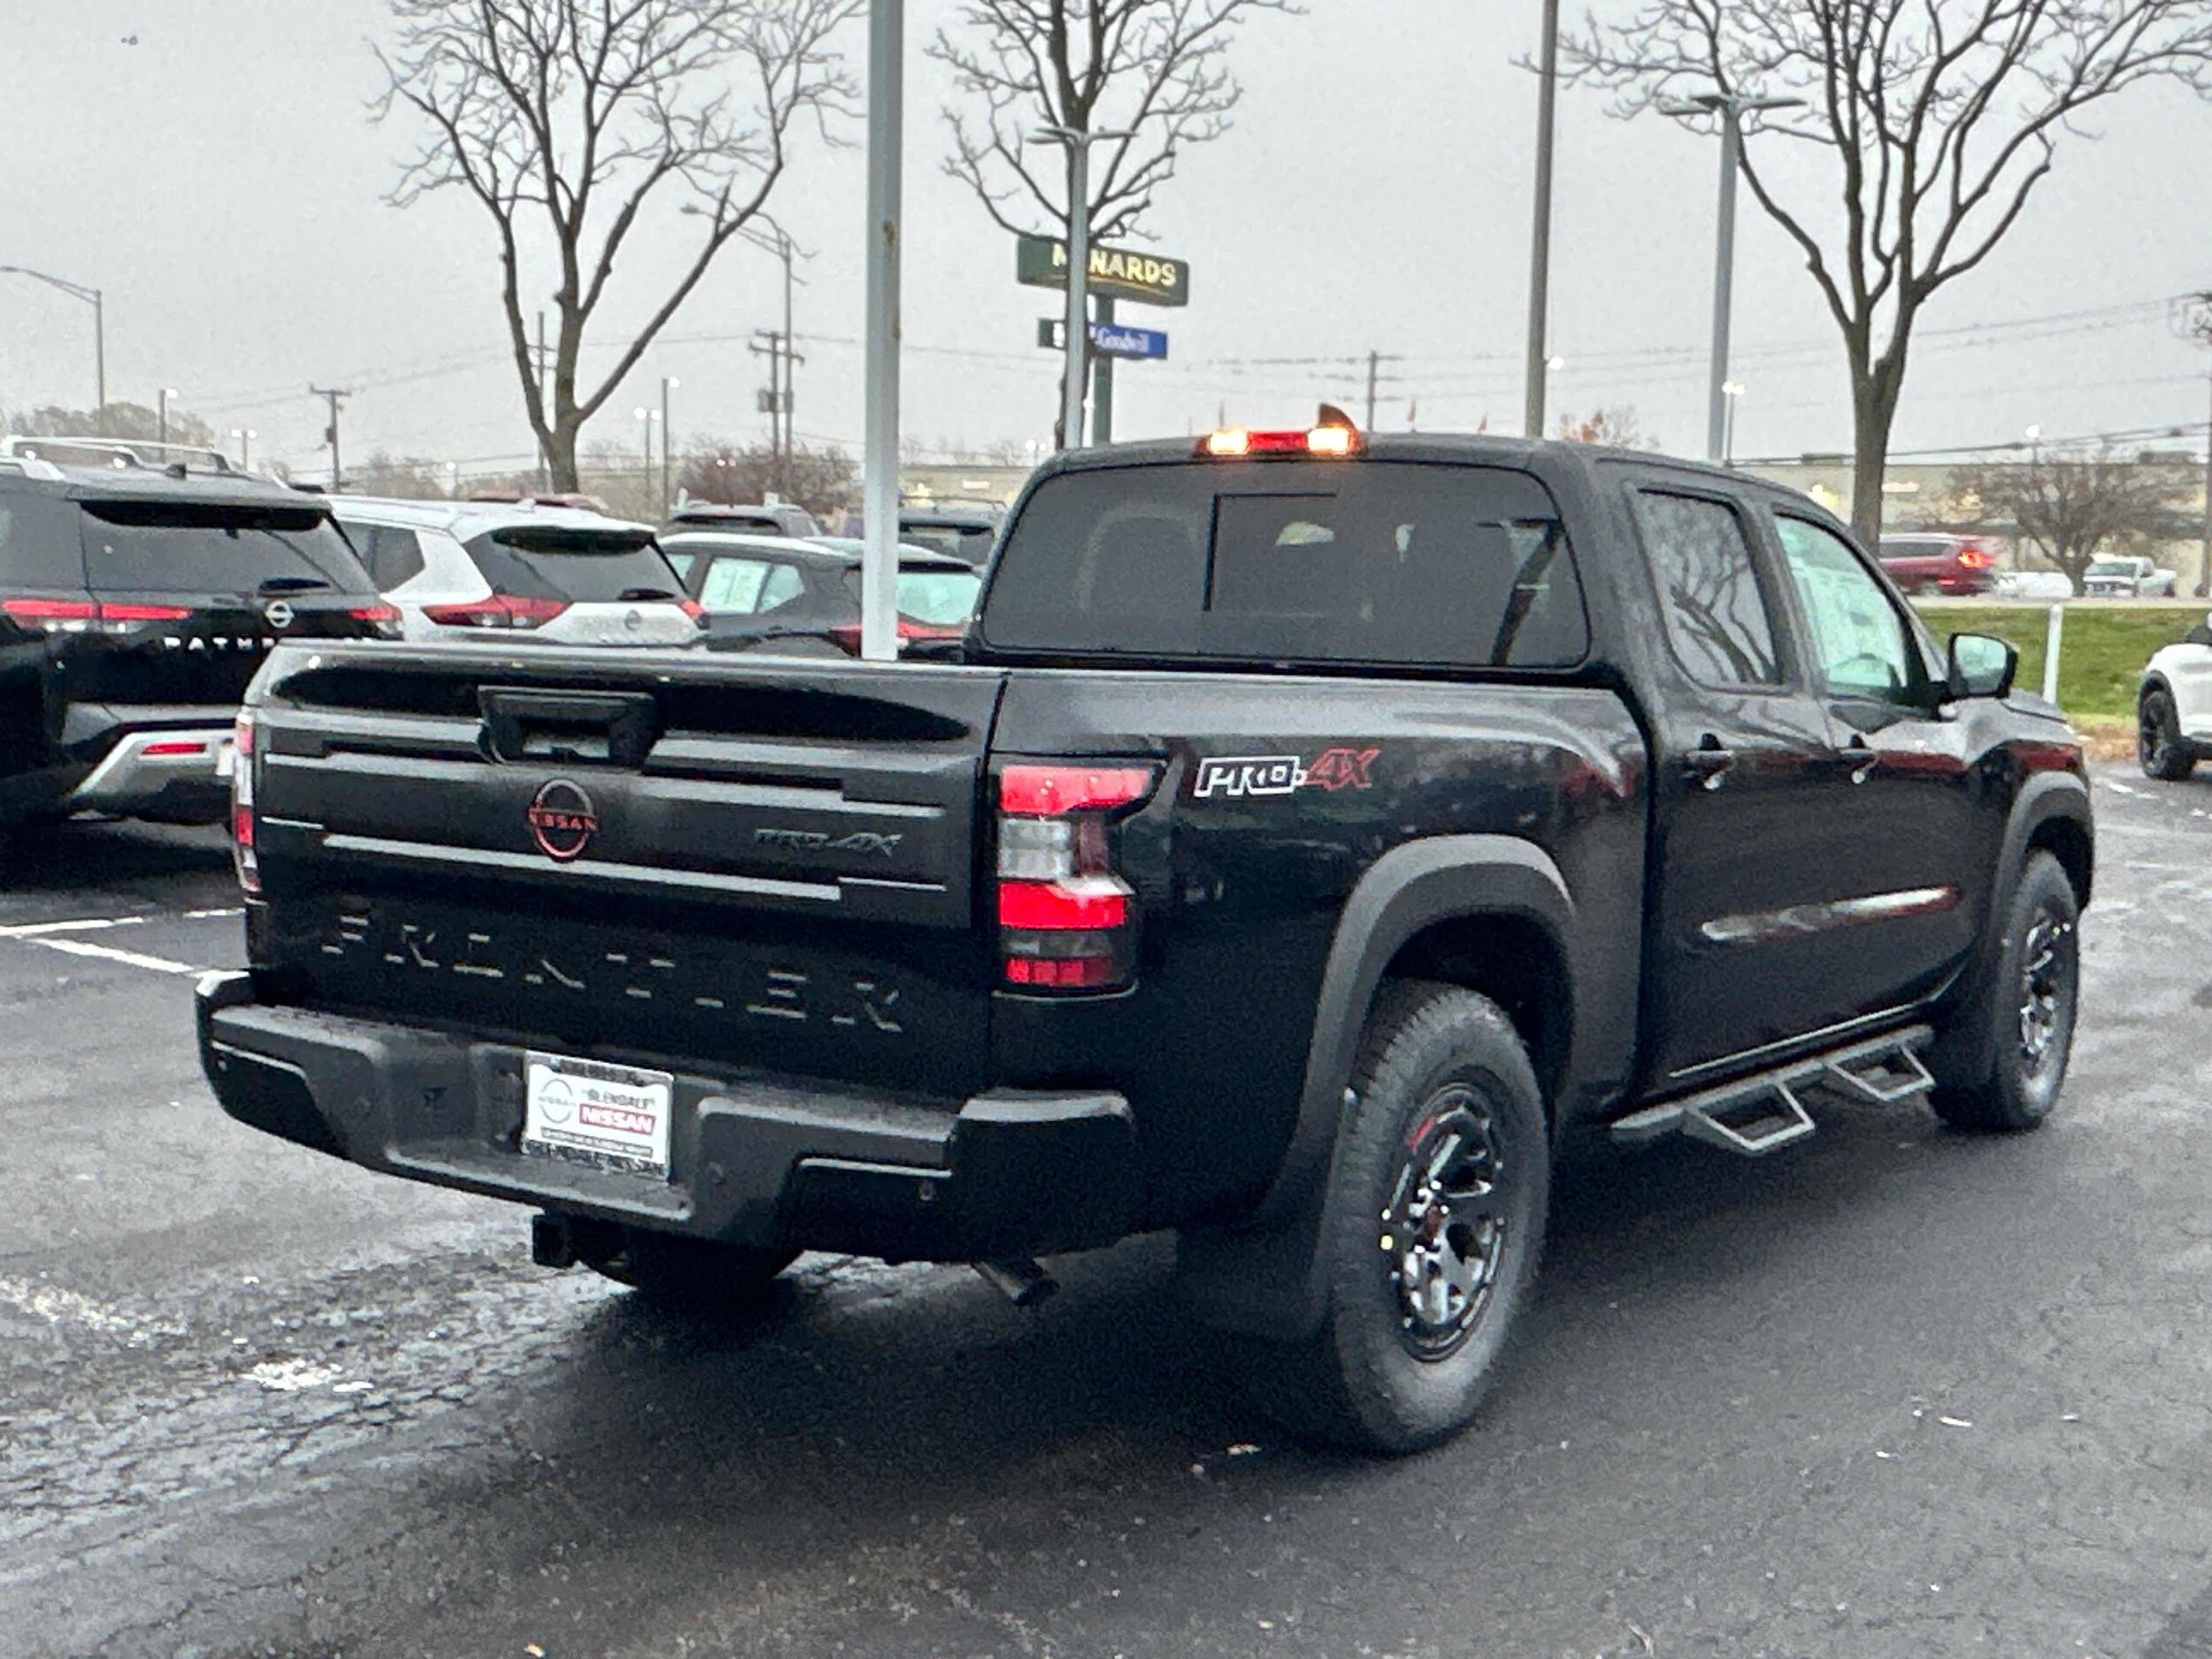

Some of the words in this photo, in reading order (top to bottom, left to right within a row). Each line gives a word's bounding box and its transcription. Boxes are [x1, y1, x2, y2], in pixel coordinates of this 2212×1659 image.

[1052, 243, 1177, 287] MNARDS
[320, 915, 902, 1033] FRONTIER
[580, 1105, 653, 1133] NISSAN
